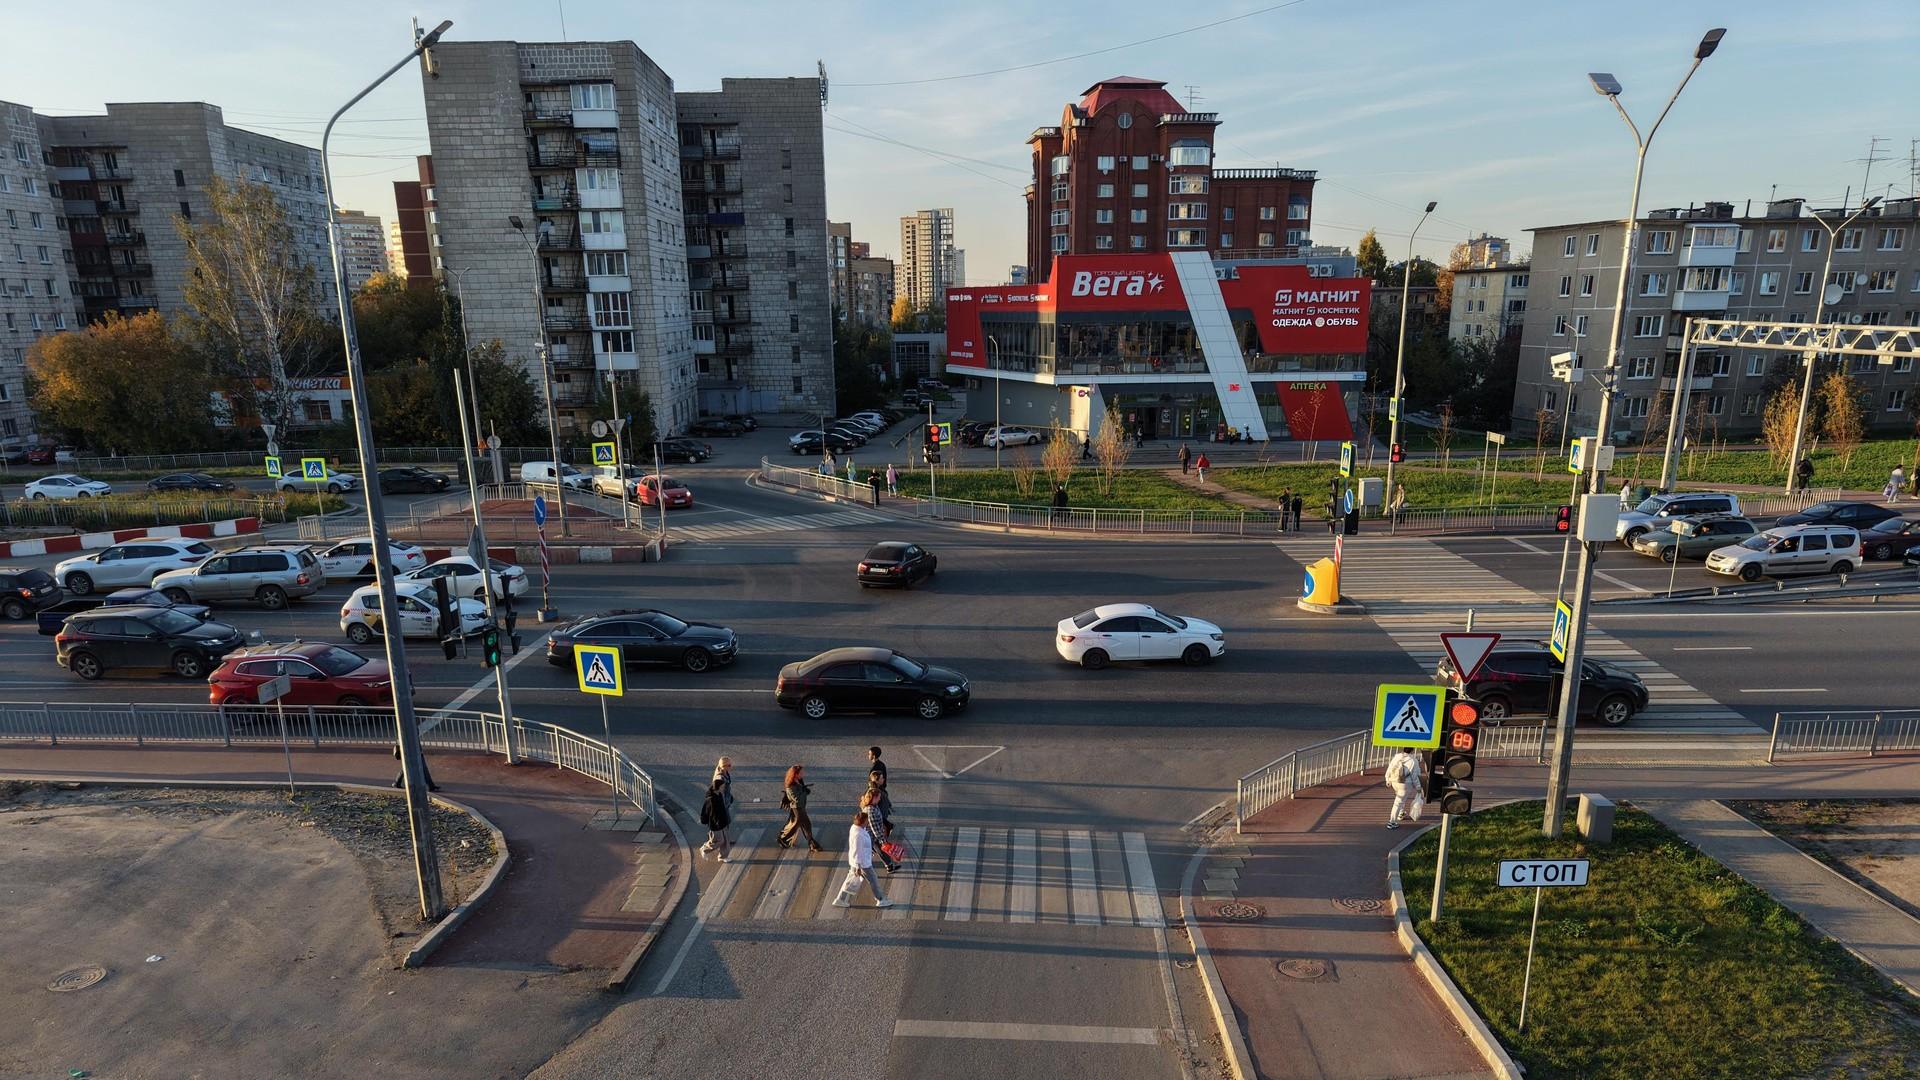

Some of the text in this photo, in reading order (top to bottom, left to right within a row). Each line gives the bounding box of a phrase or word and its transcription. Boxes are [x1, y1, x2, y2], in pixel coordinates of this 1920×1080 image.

[1296, 291, 1360, 302] МАГНИТ
[1272, 318, 1358, 327] ОДЕЖДА ОБУВЬ
[1290, 382, 1327, 390] АПТЕКА
[1453, 732, 1473, 749] 89
[1511, 864, 1577, 883] СТОП
